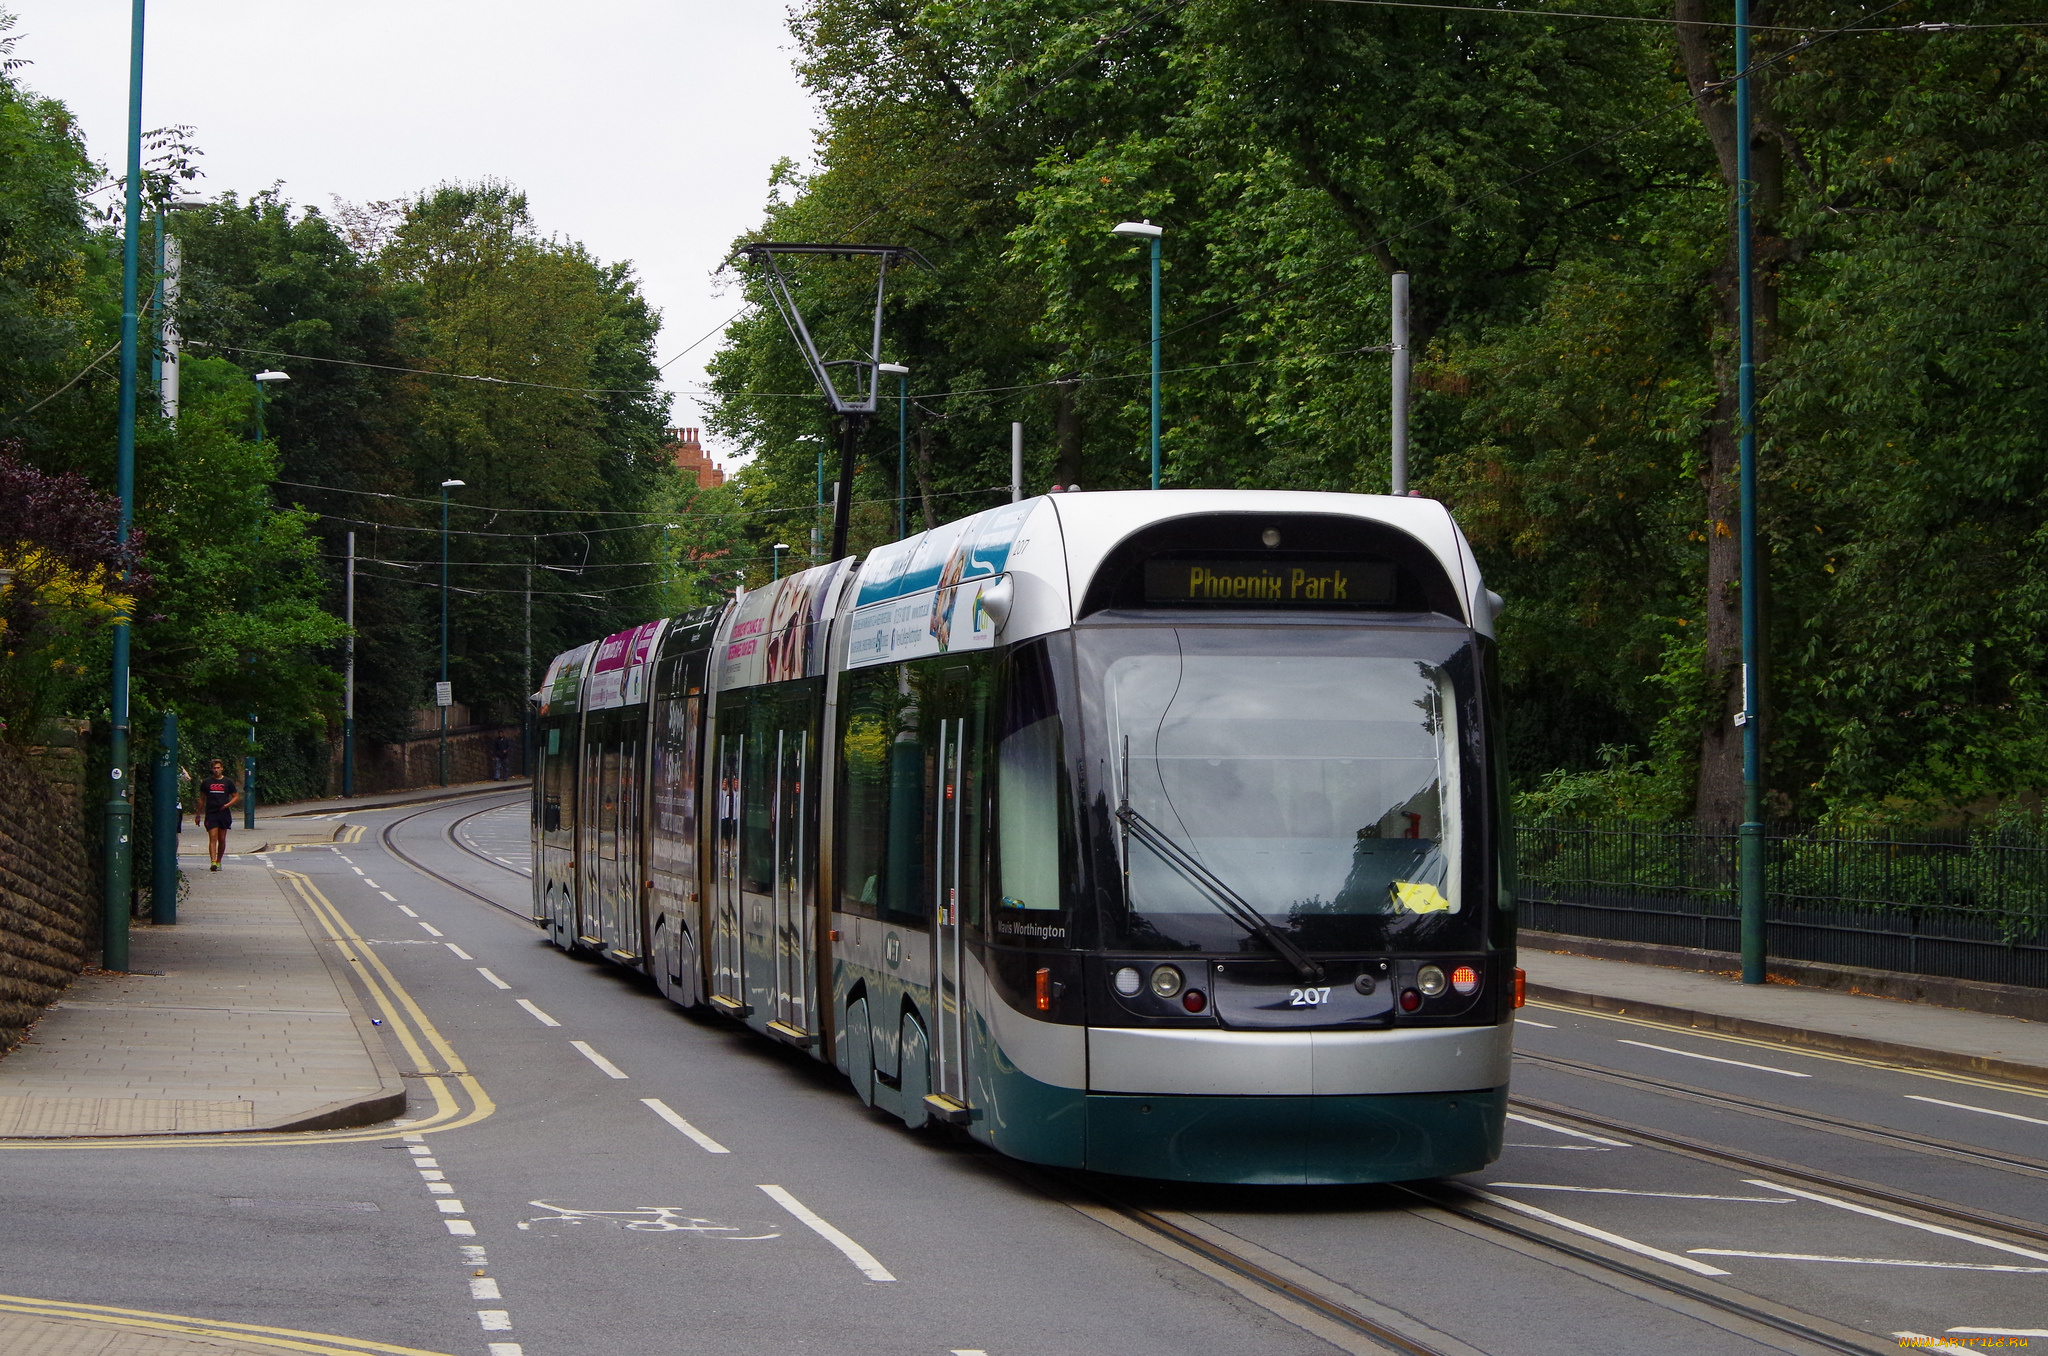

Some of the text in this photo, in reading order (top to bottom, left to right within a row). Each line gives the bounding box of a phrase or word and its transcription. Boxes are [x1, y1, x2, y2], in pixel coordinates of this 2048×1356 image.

[1190, 566, 1347, 599] Phoenix Park
[1013, 921, 1065, 940] Worthington
[1290, 987, 1330, 1006] 207
